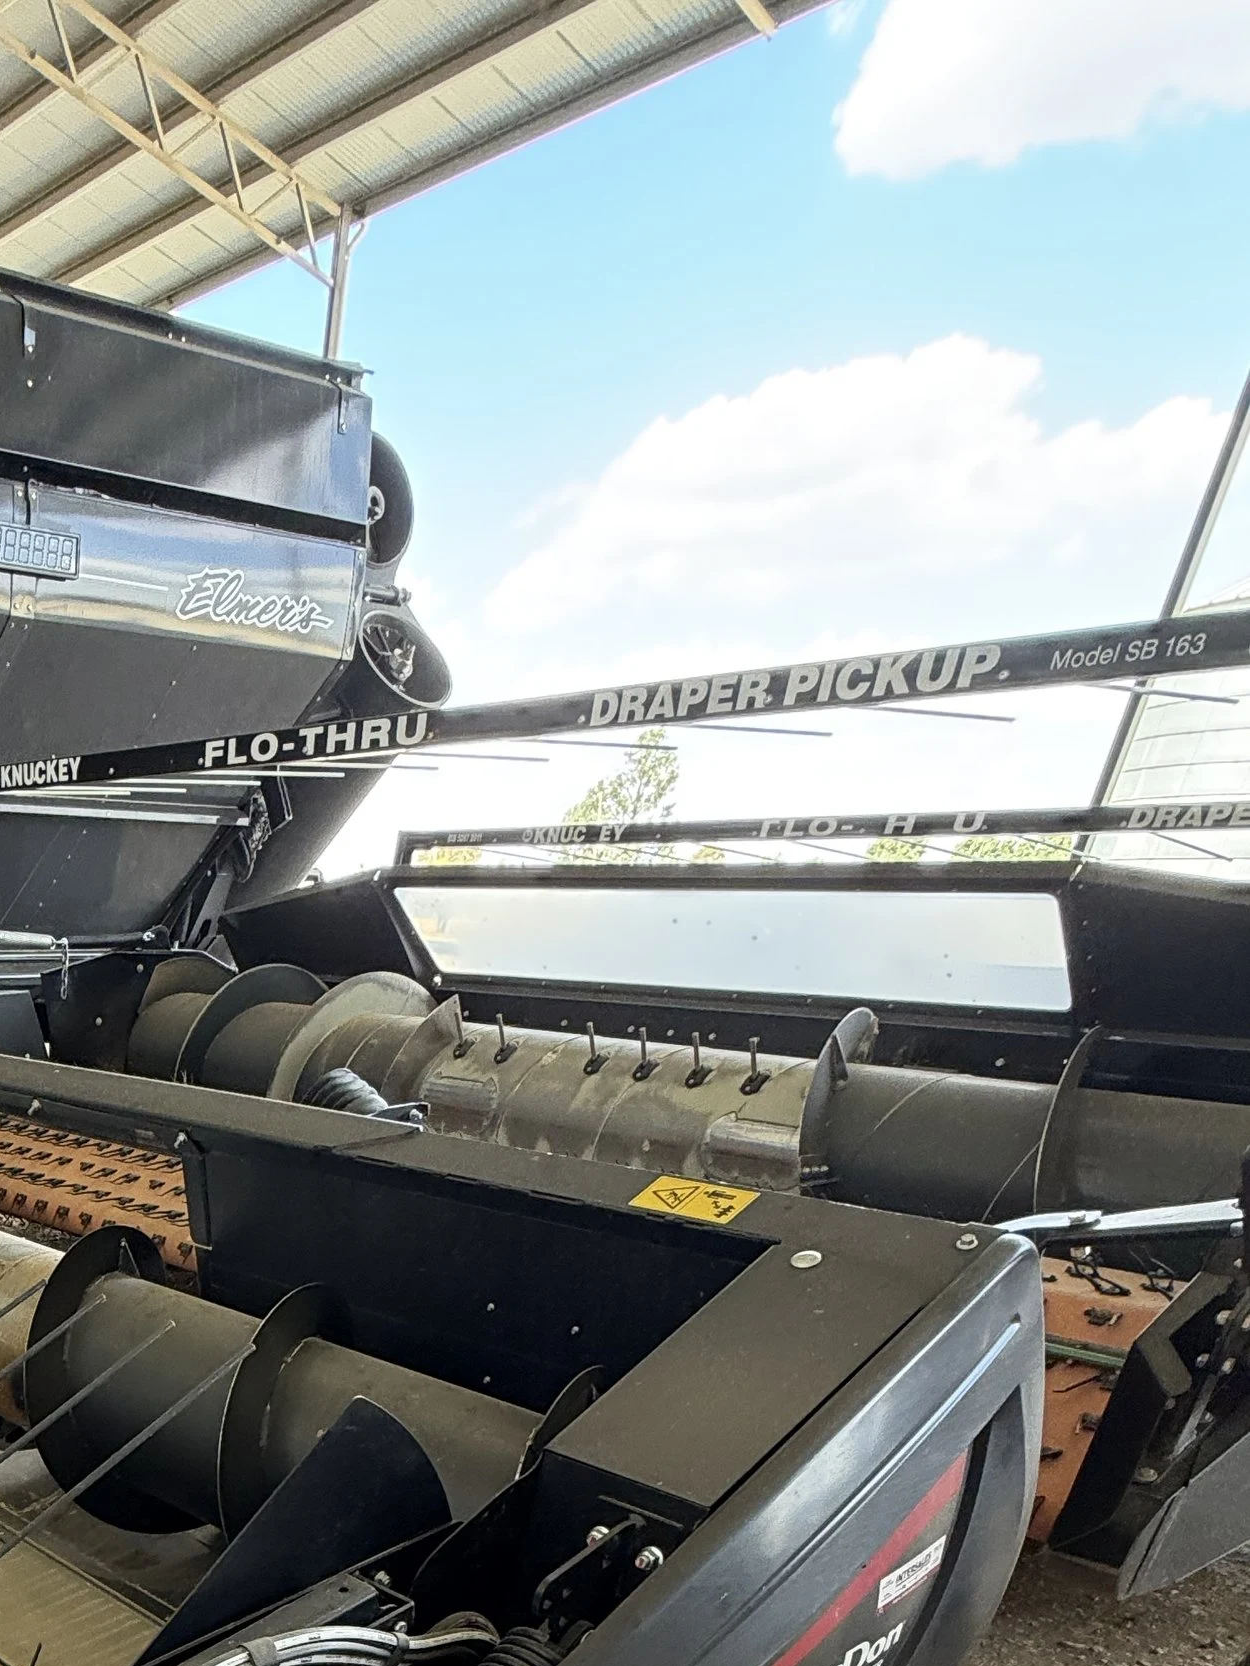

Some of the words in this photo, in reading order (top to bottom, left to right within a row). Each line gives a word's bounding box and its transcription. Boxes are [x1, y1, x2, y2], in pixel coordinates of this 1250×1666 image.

[175, 567, 334, 633] Elmer's
[0, 756, 81, 788] KNUCKEY
[204, 713, 428, 768] FLO-THRU
[590, 673, 769, 727] DRAPER
[783, 644, 1001, 706] PICKUP
[1050, 643, 1121, 671] Model
[1125, 638, 1159, 662] SB
[1166, 633, 1207, 657] 163
[533, 825, 628, 844] KNUCEY
